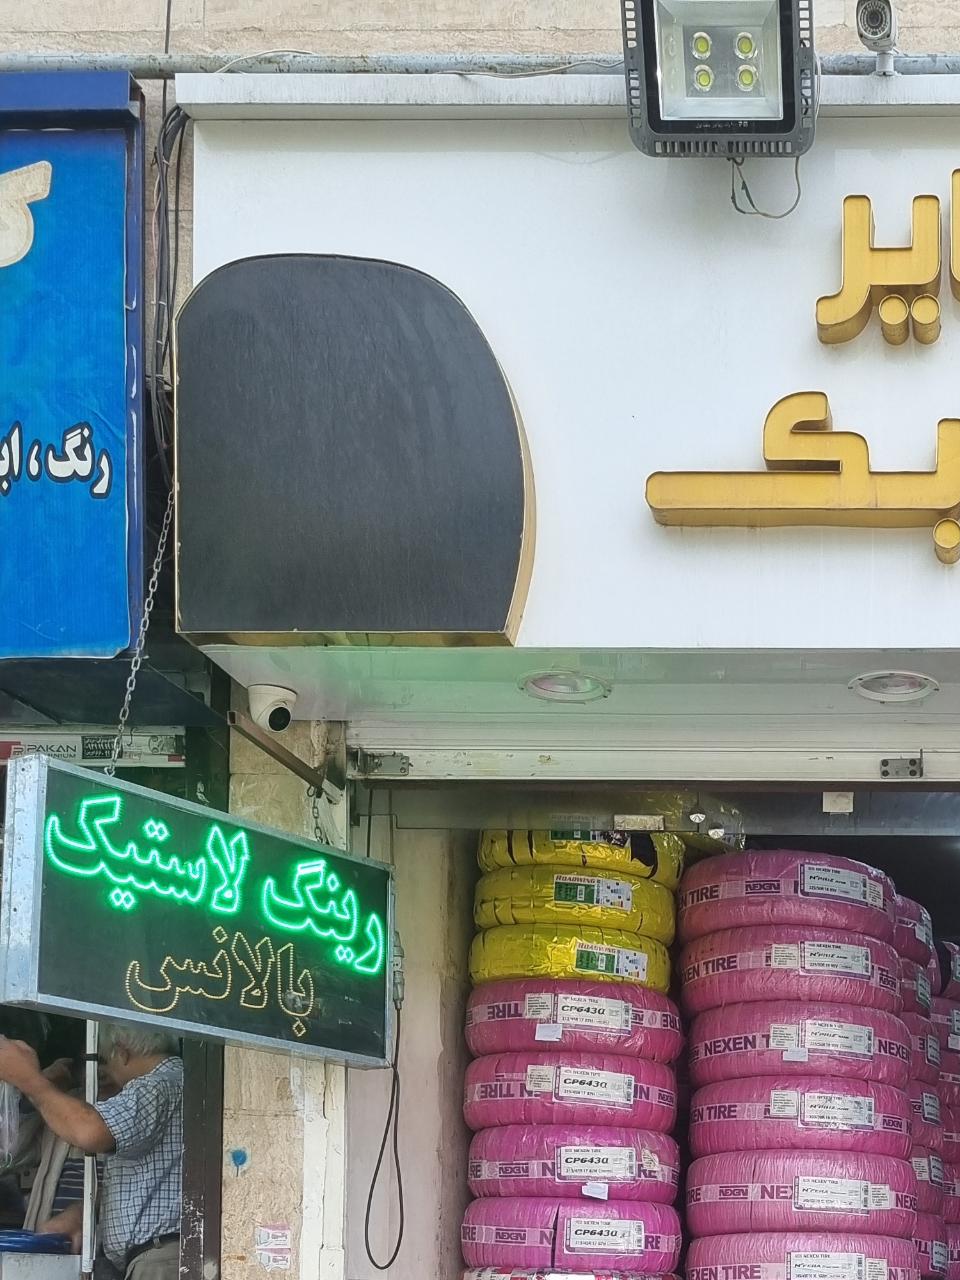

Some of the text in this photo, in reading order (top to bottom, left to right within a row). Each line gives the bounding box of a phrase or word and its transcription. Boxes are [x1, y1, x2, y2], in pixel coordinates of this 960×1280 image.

[27, 743, 77, 753] PAKAN
[46, 796, 384, 974] رینگ لاستیک
[555, 875, 596, 885] ROADWING
[690, 885, 719, 903] TIRE
[577, 941, 617, 954] ROADWING
[702, 955, 737, 975] TIRE
[125, 926, 315, 1037] بالانس
[704, 1034, 756, 1056] NEXEN
[707, 1104, 737, 1120] TIRE
[722, 1264, 761, 1280] TIRE
